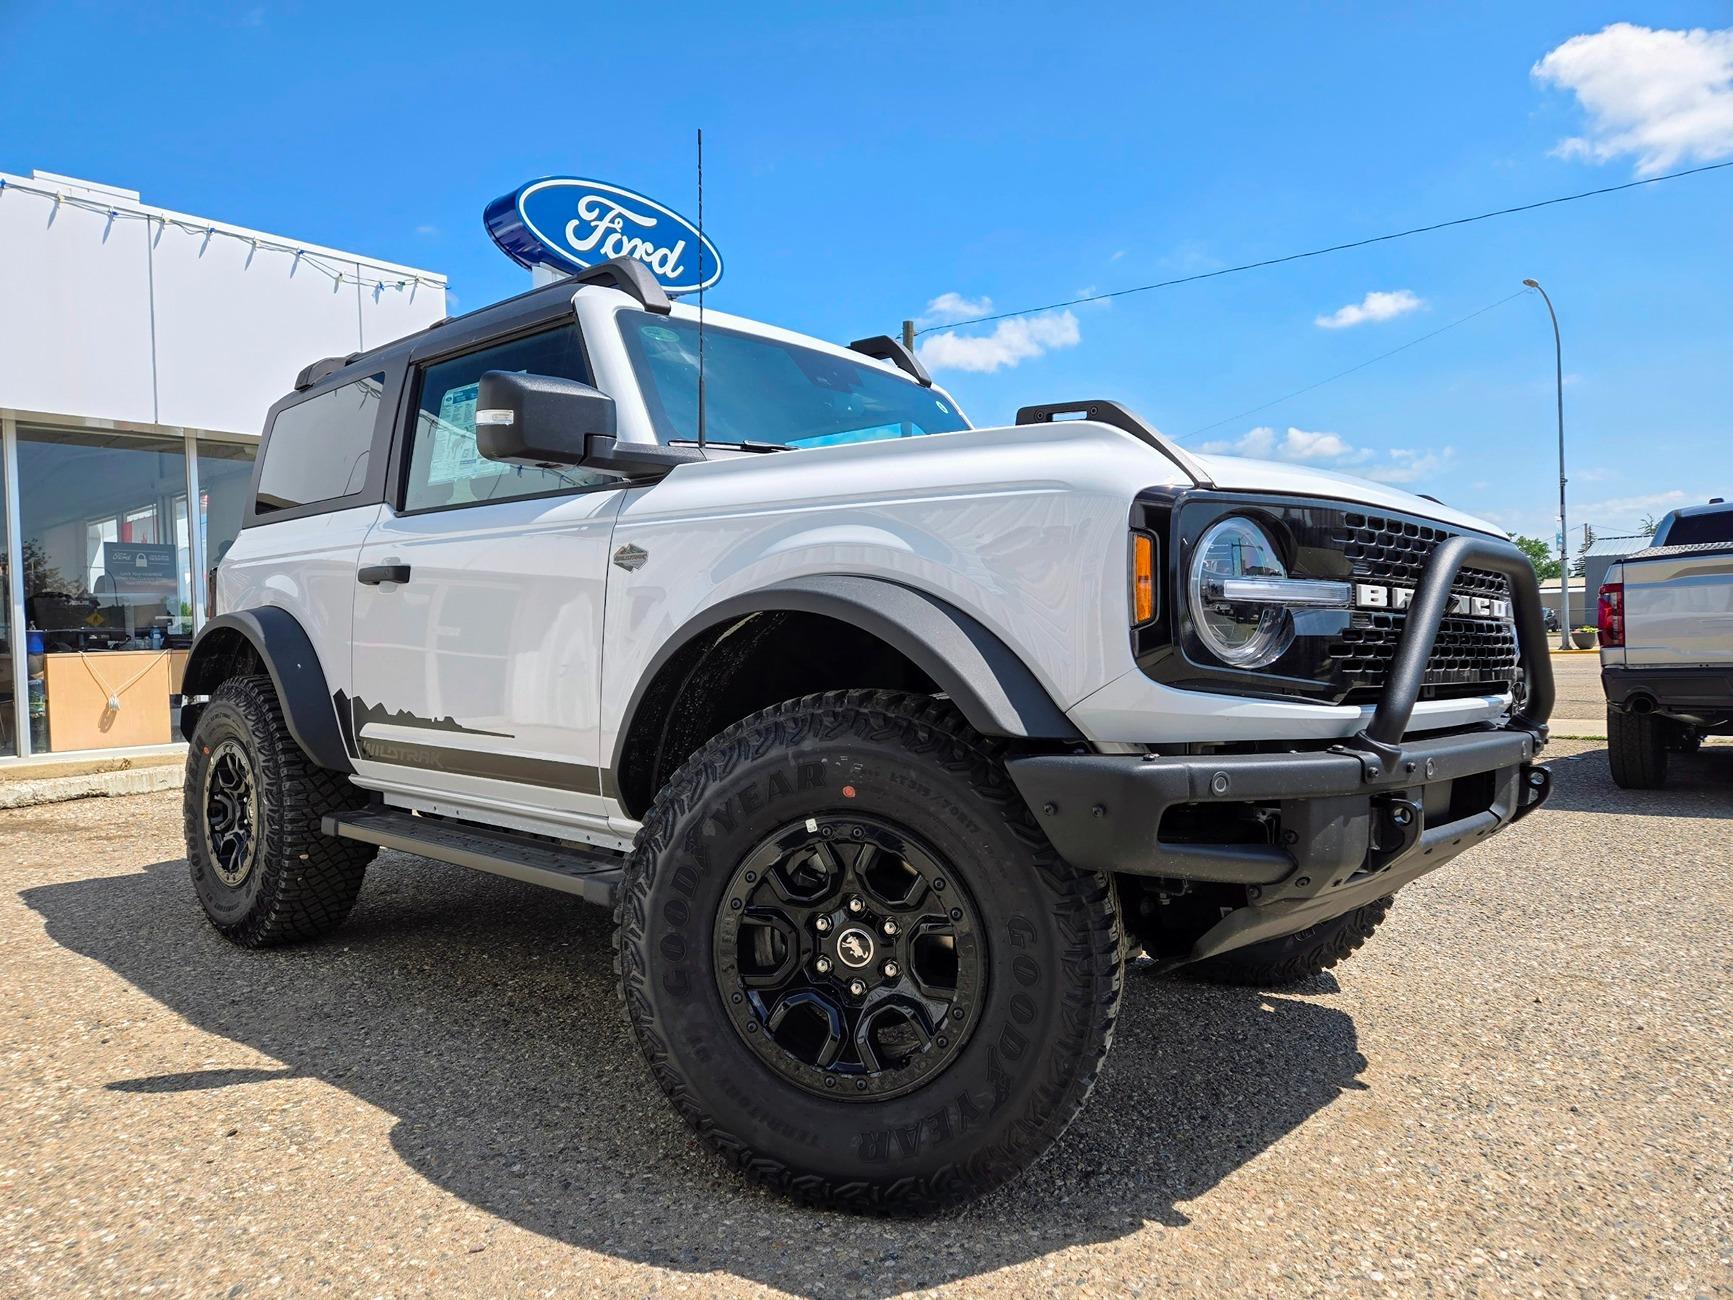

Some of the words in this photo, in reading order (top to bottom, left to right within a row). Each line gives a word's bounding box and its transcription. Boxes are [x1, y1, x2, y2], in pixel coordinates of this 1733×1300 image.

[565, 195, 686, 278] Ford
[363, 740, 444, 769] WILDTRAK
[662, 761, 828, 998] GOODYEAR
[855, 914, 1043, 1166] GOODYEAR
